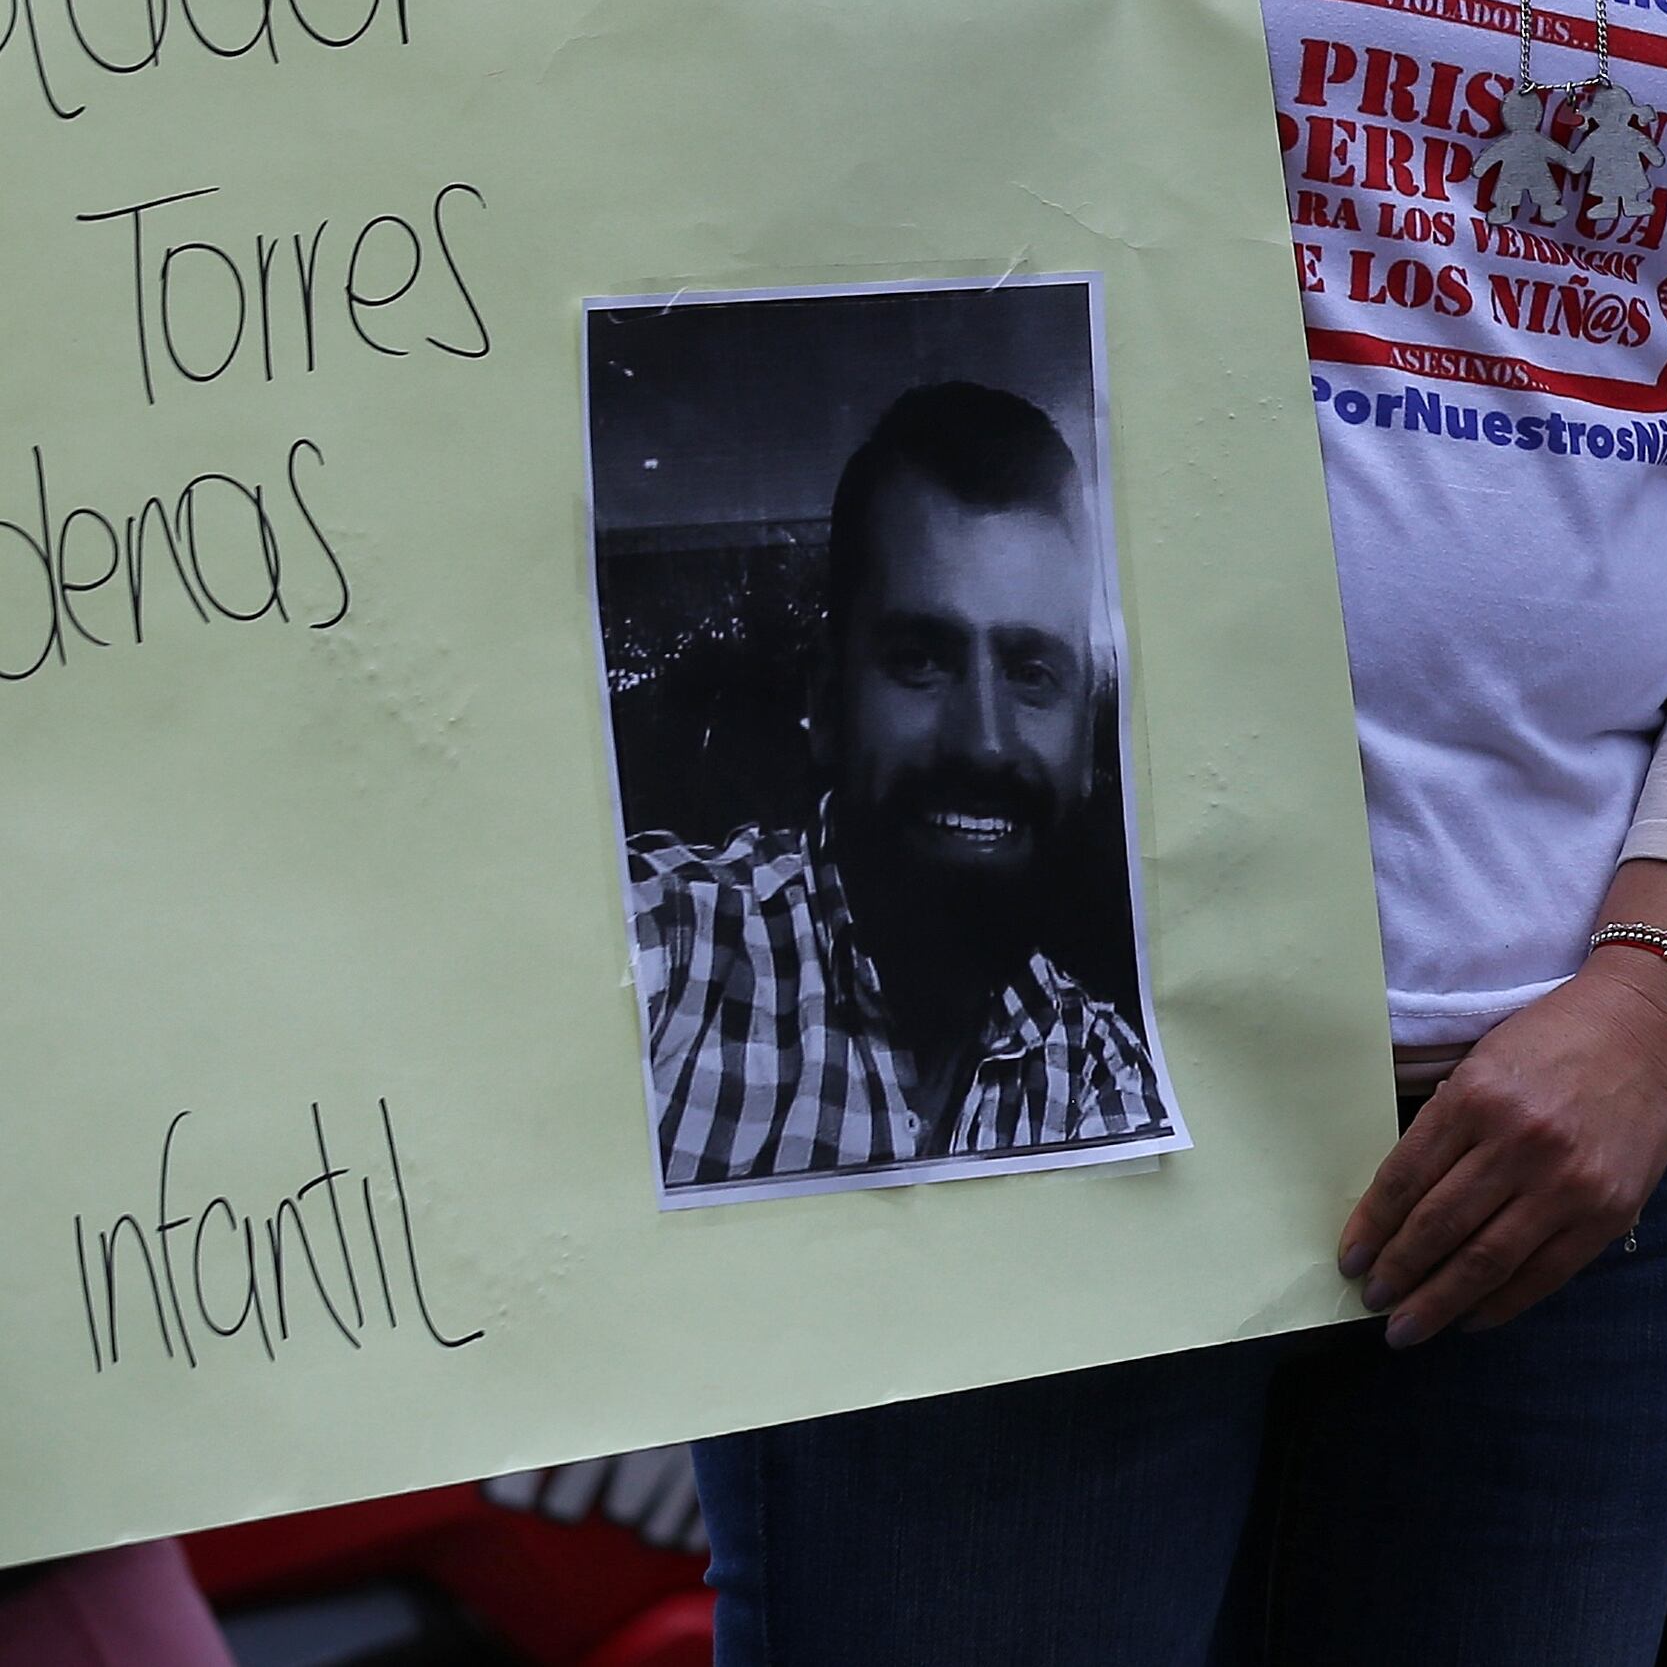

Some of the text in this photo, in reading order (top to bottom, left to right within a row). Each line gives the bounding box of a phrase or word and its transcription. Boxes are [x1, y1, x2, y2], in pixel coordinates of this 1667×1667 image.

[1377, 203, 1456, 247] LOS
[77, 184, 490, 405] Torres
[1348, 250, 1473, 318] LOS
[1490, 271, 1651, 349] NIÑ@S
